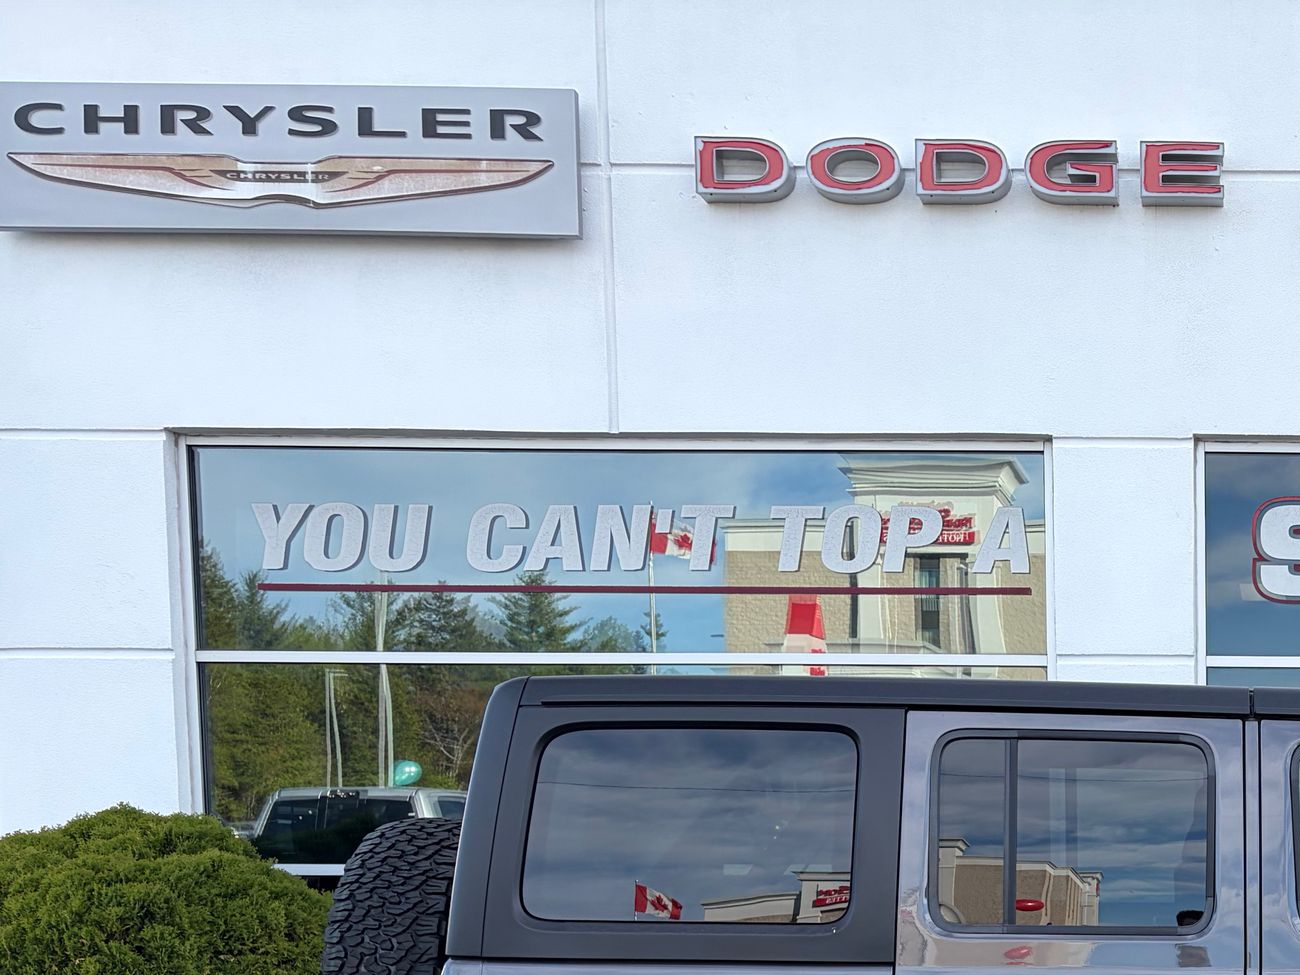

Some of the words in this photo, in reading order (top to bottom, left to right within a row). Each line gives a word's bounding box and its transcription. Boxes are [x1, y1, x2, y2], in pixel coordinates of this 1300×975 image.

[13, 102, 546, 142] CHRYSLER
[226, 172, 329, 181] CHRYSLER
[693, 136, 1225, 207] DODGE
[251, 502, 431, 573] YOU
[467, 503, 736, 573] CAN'T
[769, 504, 944, 575] TOP
[971, 506, 1031, 575] A
